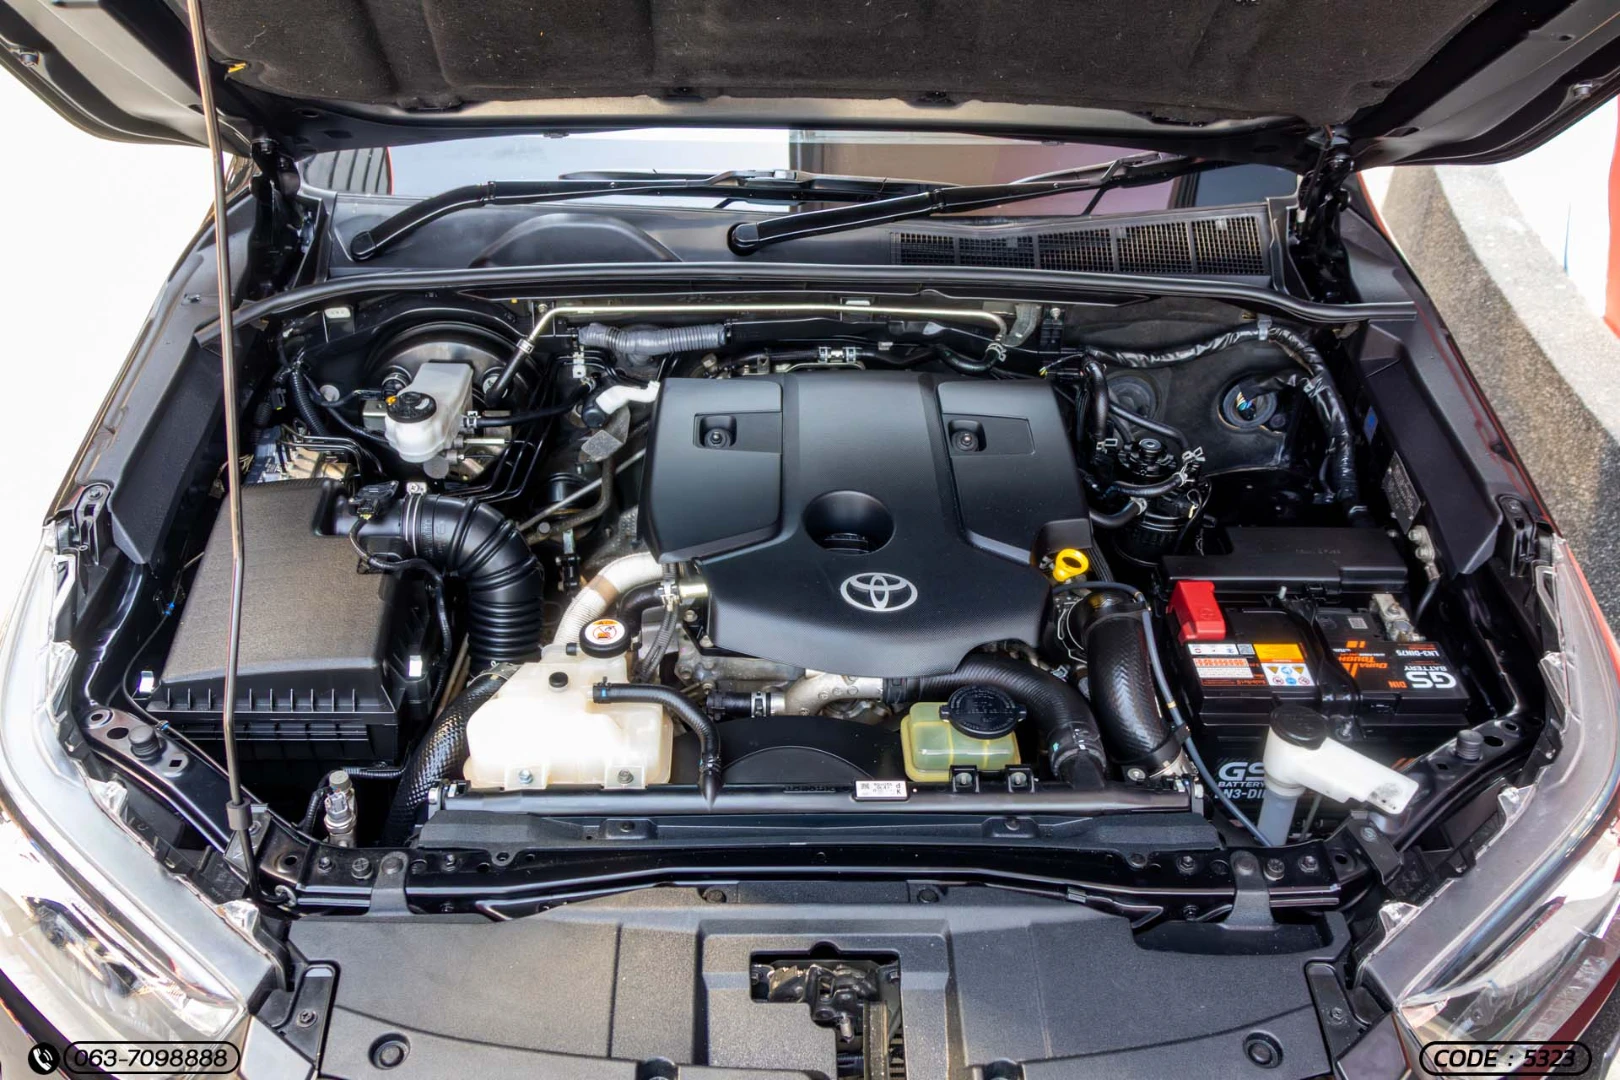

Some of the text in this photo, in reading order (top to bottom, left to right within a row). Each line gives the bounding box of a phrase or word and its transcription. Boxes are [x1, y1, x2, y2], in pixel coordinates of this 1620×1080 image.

[1387, 680, 1407, 688] DIN
[1405, 671, 1457, 689] GS
[1218, 762, 1265, 781] GS
